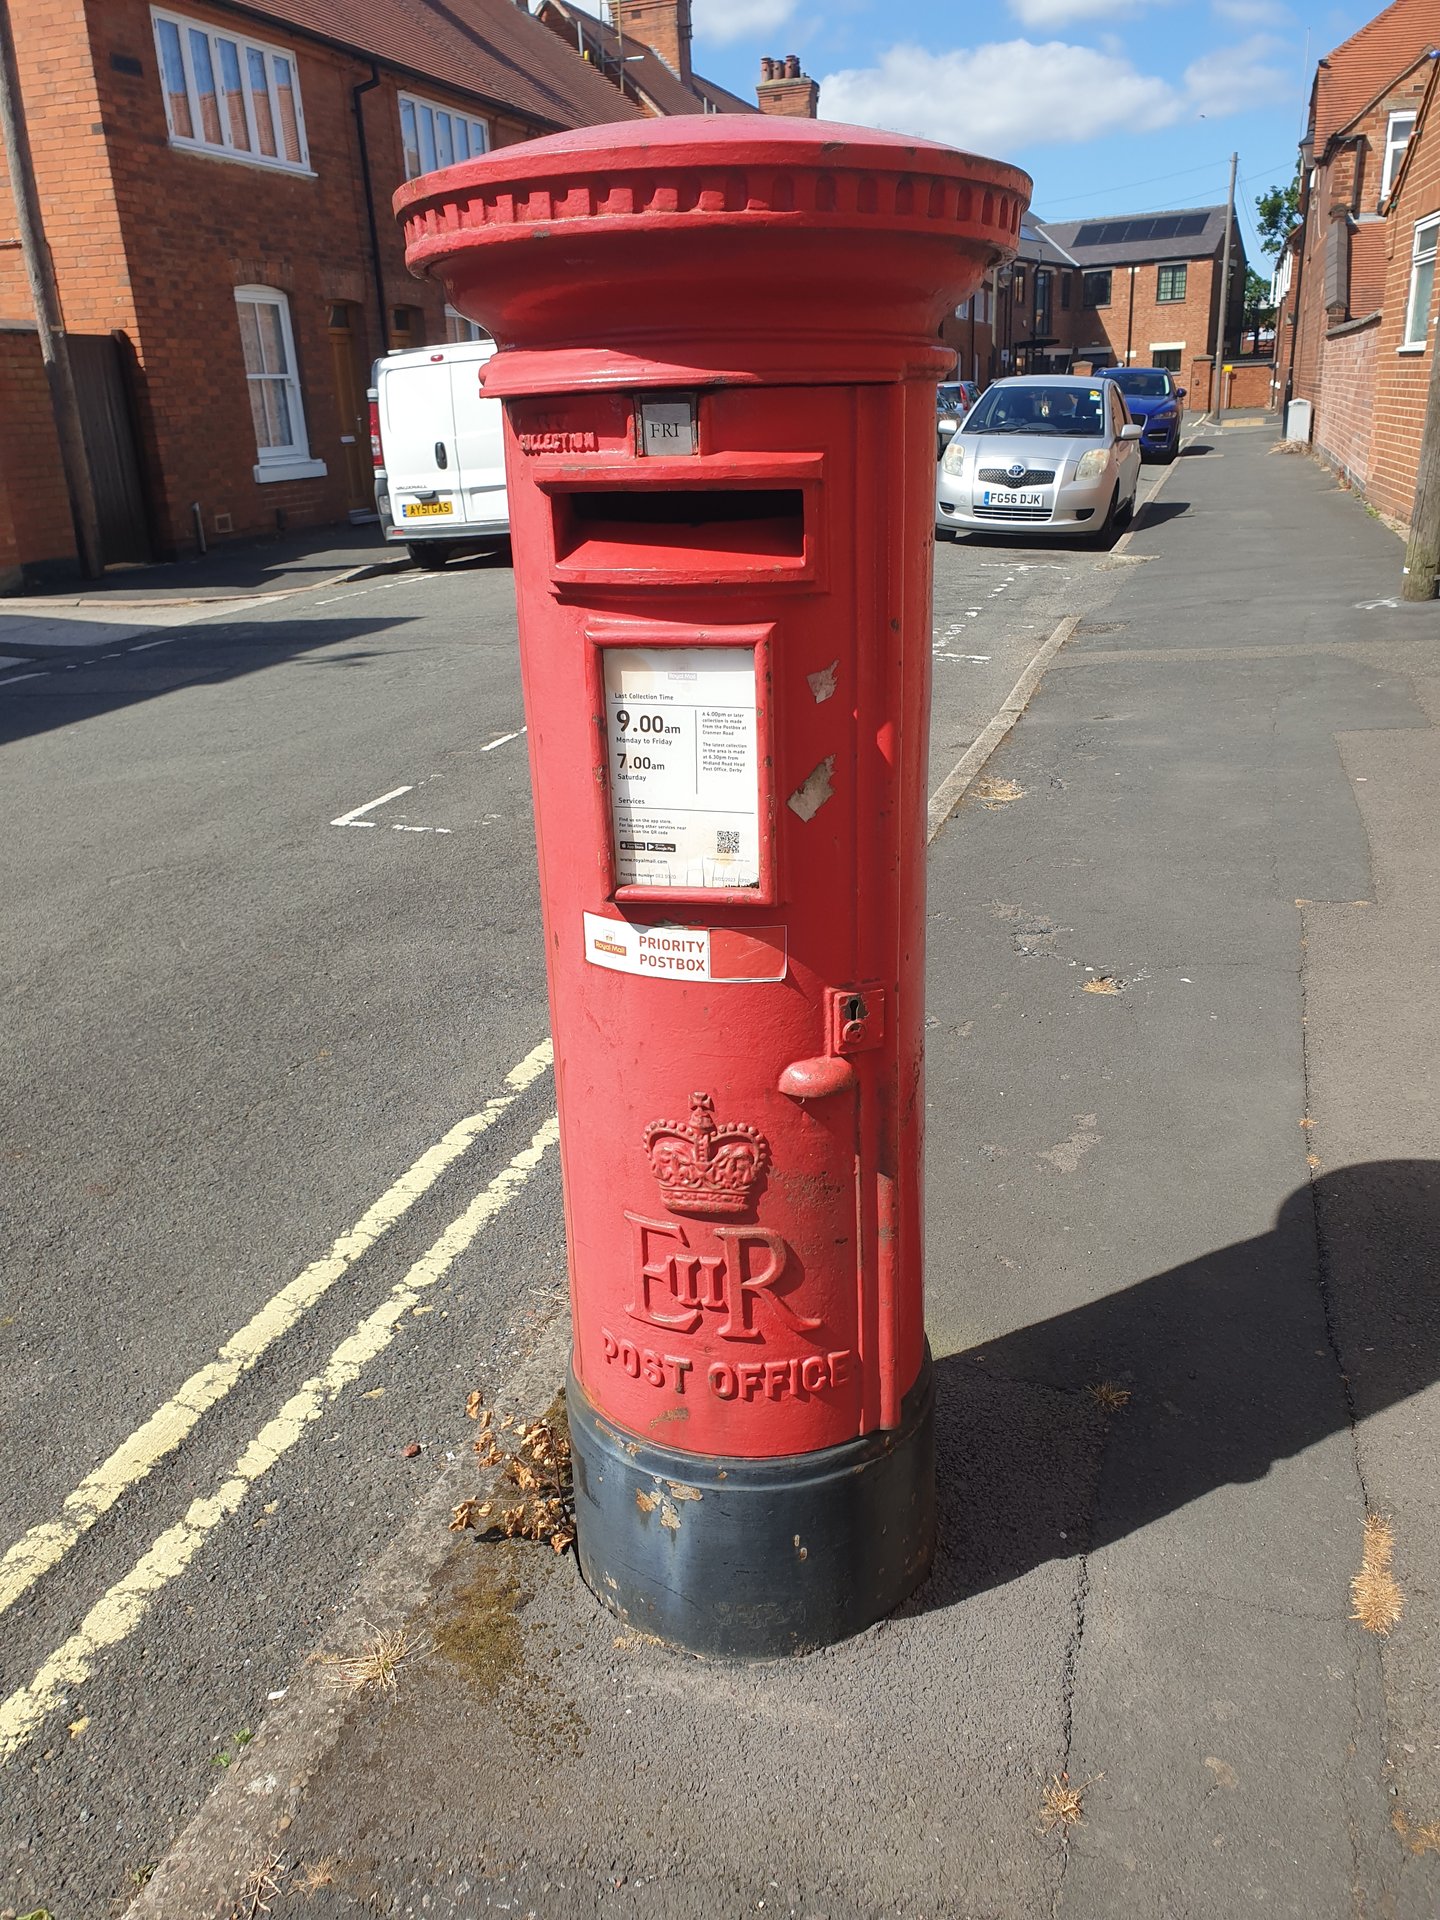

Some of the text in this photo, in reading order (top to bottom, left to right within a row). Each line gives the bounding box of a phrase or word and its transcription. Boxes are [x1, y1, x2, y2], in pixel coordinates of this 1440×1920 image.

[650, 423, 680, 438] FRI
[990, 493, 1040, 504] FG56 DJK
[616, 710, 681, 733] 9.00am
[652, 738, 672, 746] Friday
[617, 753, 665, 770] 7.00am
[617, 773, 647, 781] Saturday
[595, 940, 610, 951] Royal
[639, 935, 705, 954] PRIORITY
[639, 953, 706, 972] POSTBOX
[600, 1326, 852, 1400] POST OFFICE
